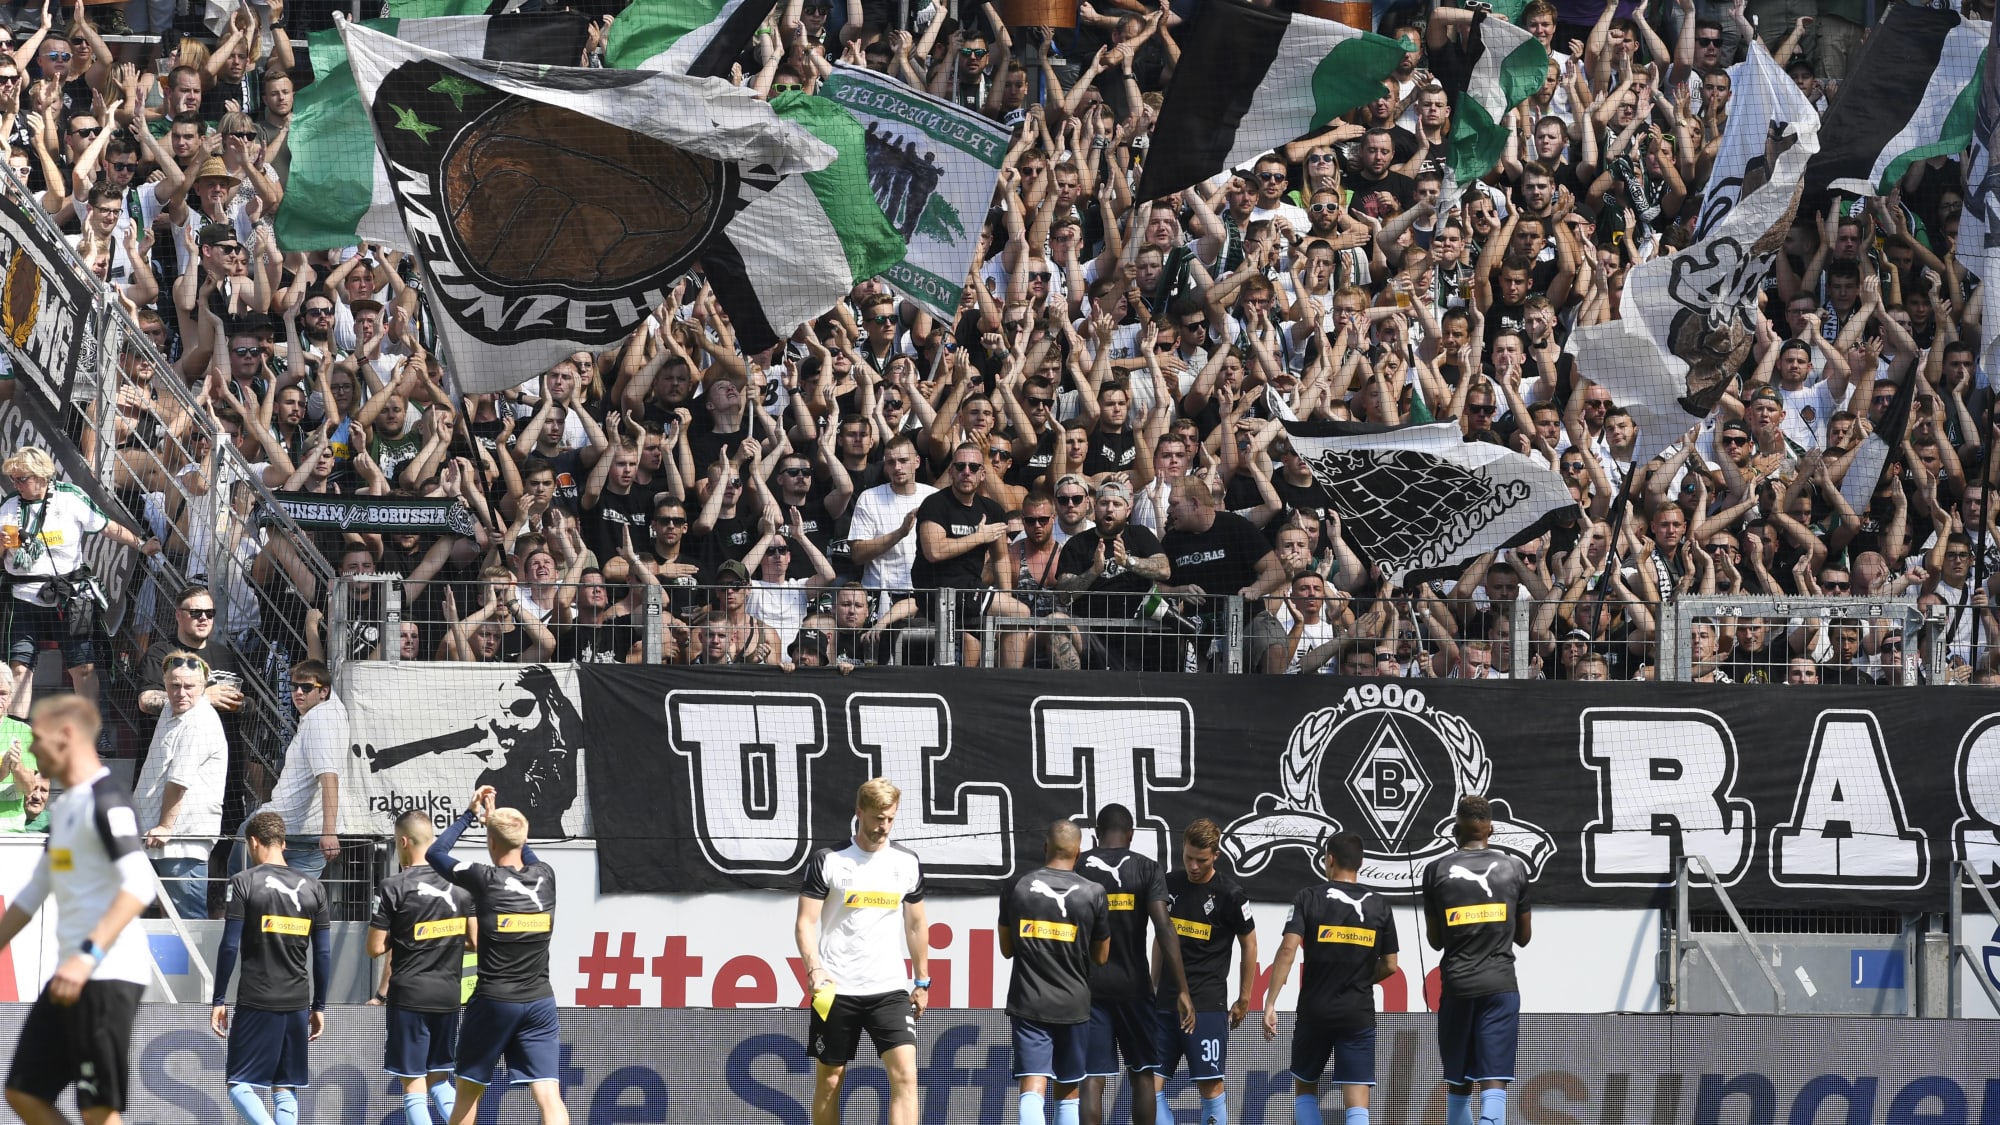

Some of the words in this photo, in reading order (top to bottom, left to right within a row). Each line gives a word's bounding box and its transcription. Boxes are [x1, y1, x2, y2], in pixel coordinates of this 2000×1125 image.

[391, 160, 690, 333] NEUNZEH
[367, 505, 447, 527] BORUSSIA
[1343, 683, 1426, 712] 1900
[1372, 758, 1408, 810] B
[369, 790, 452, 811] rabauke
[1580, 706, 2000, 890] RA
[1465, 909, 1505, 920] Postbank
[432, 921, 464, 935] Postbank
[1037, 926, 1076, 938] Postbank
[1176, 923, 1209, 937] Postbank
[1336, 931, 1373, 943] Postbank
[1855, 956, 1863, 984] J
[1201, 1039, 1220, 1062] 30
